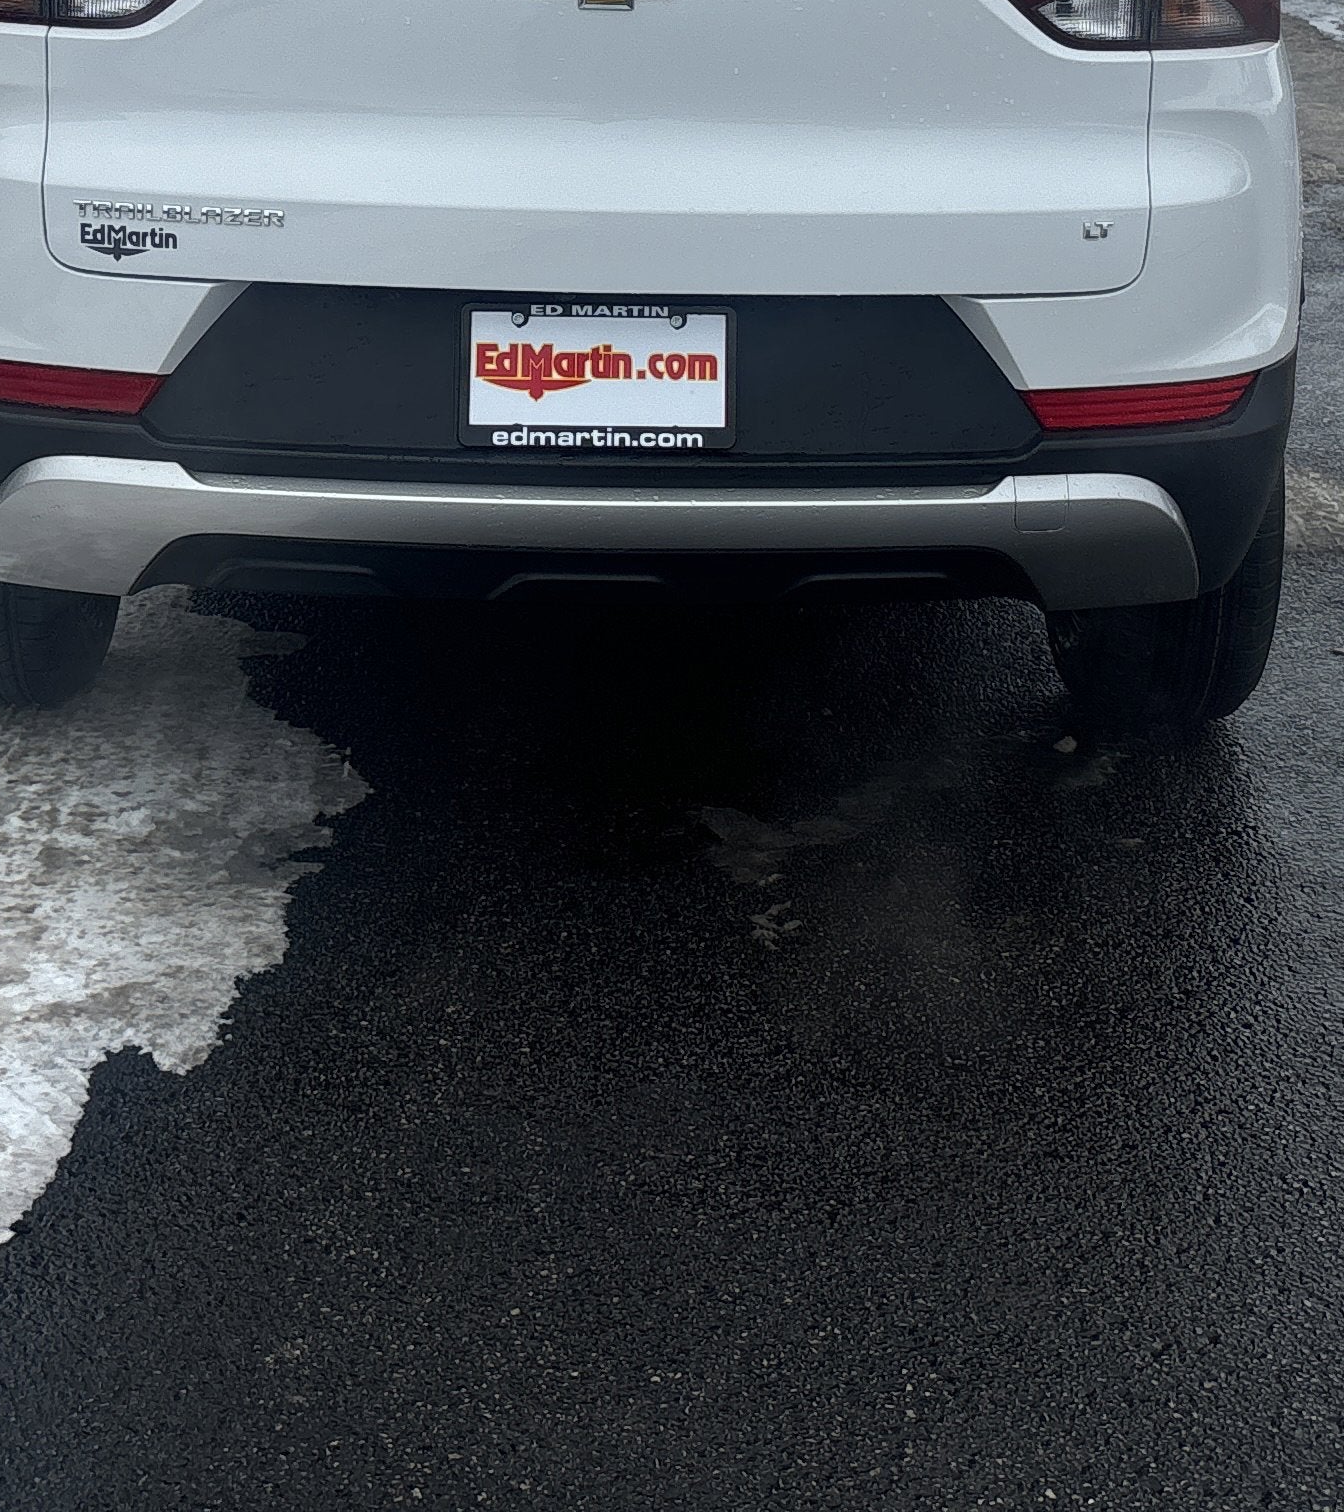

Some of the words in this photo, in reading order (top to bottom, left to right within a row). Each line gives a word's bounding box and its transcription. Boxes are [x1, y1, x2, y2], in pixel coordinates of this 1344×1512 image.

[72, 199, 285, 228] TRAILBLAZER
[1082, 221, 1115, 240] LT
[530, 304, 563, 316] ED
[571, 305, 669, 317] MARTIN
[492, 427, 703, 448] edmartin.com
